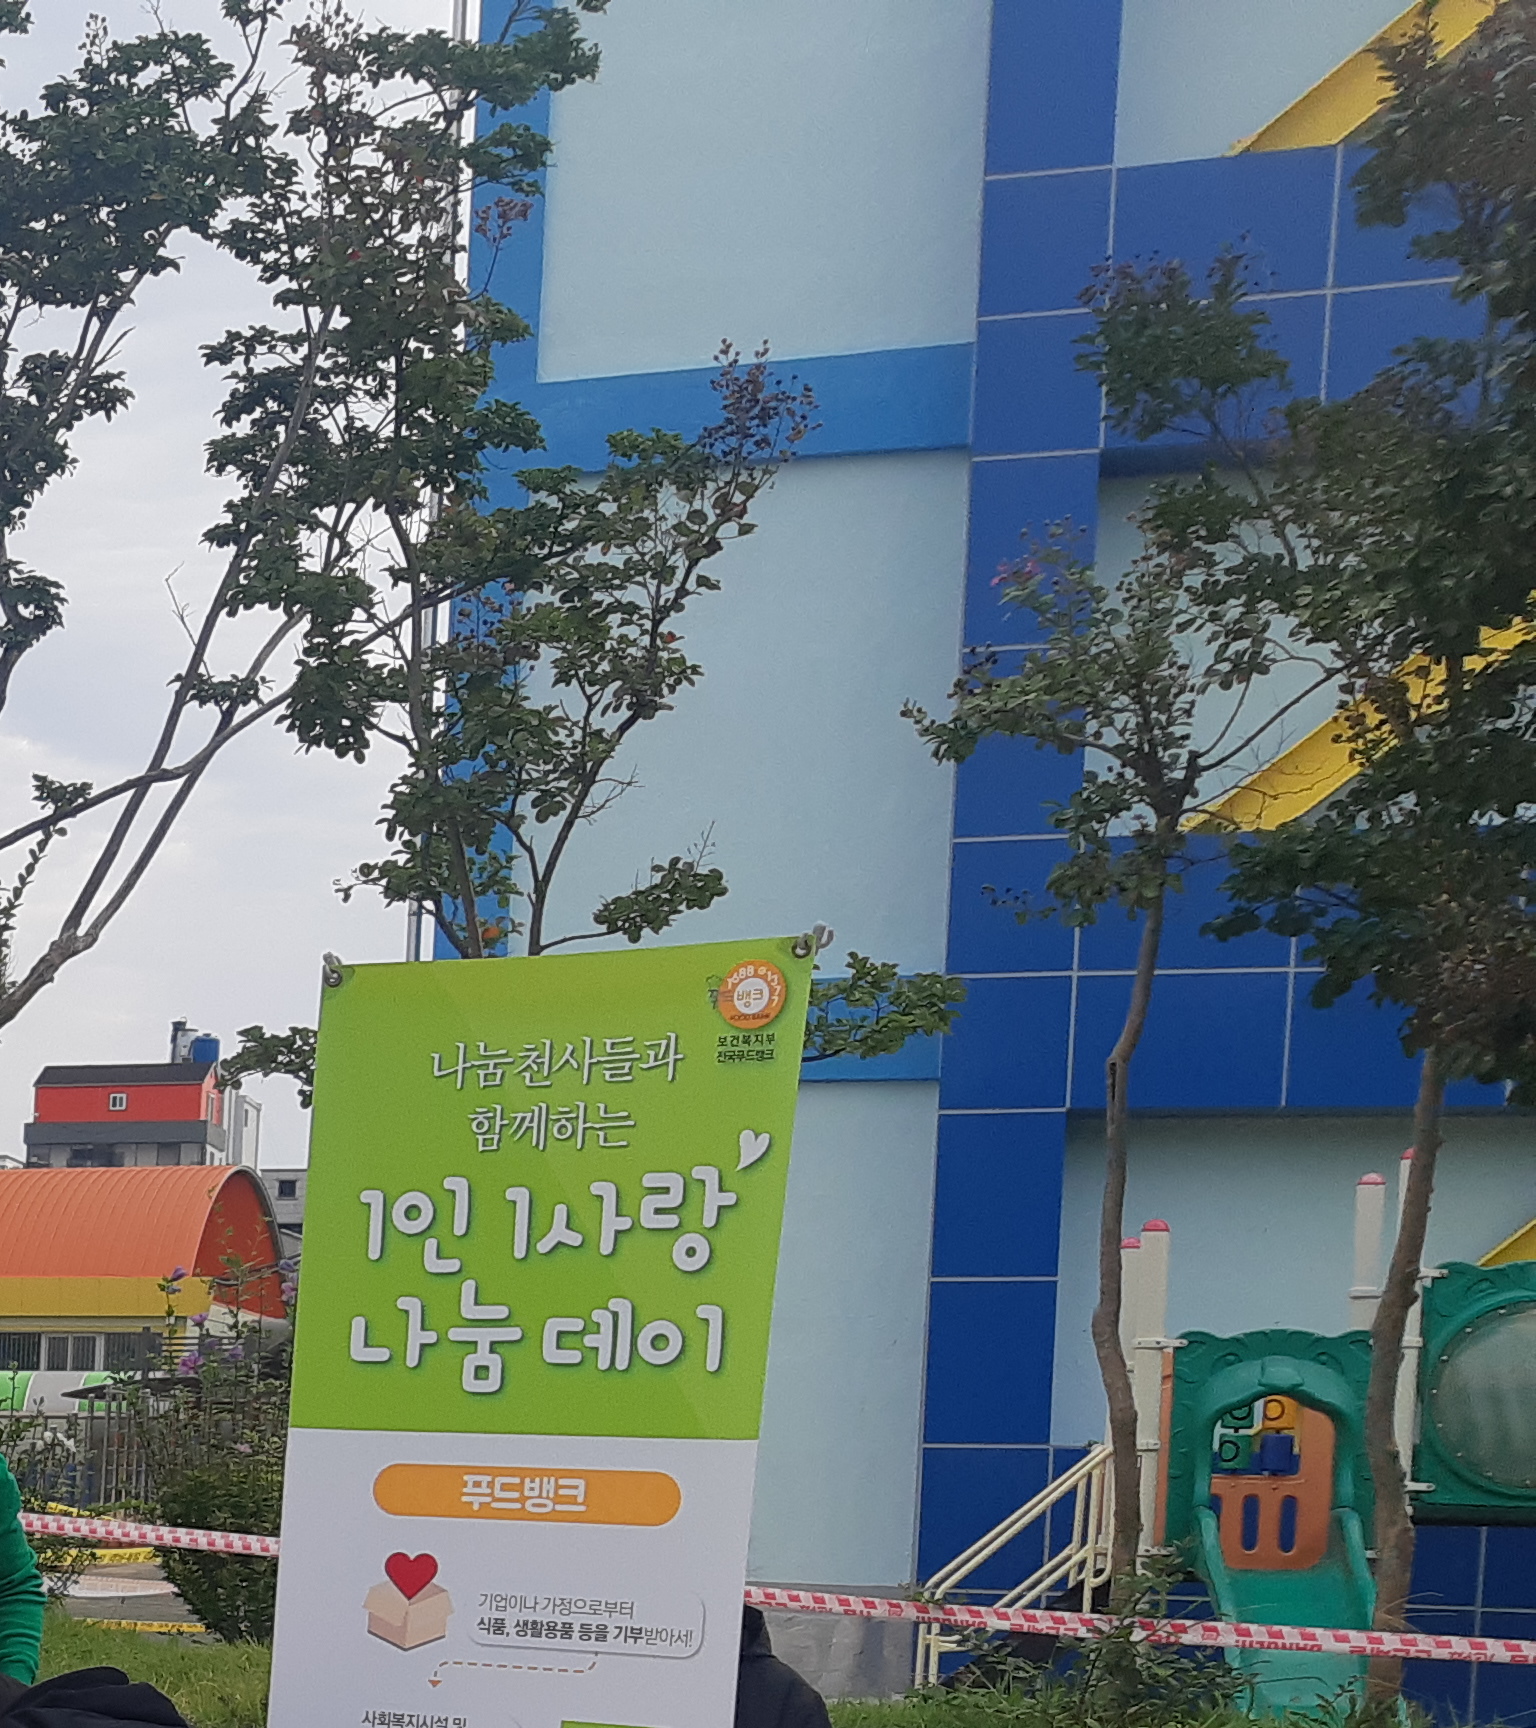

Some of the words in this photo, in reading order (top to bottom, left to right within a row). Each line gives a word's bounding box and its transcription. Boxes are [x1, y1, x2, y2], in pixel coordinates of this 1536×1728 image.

[431, 1032, 684, 1089] 나눔천사들과
[469, 1101, 635, 1152] 함께하는
[359, 1176, 470, 1275] 1인
[504, 1165, 738, 1273] 1사랑
[349, 1279, 524, 1394] 나눔
[541, 1297, 724, 1373] 데이
[461, 1473, 588, 1514] 푸드뱅크
[478, 1592, 539, 1614] 기업이나
[542, 1596, 635, 1620] 가정으로부터
[476, 1616, 510, 1638] 식품,
[513, 1620, 575, 1640] 생활용품
[578, 1625, 610, 1643] 등을
[613, 1623, 693, 1648] 기부받아서!
